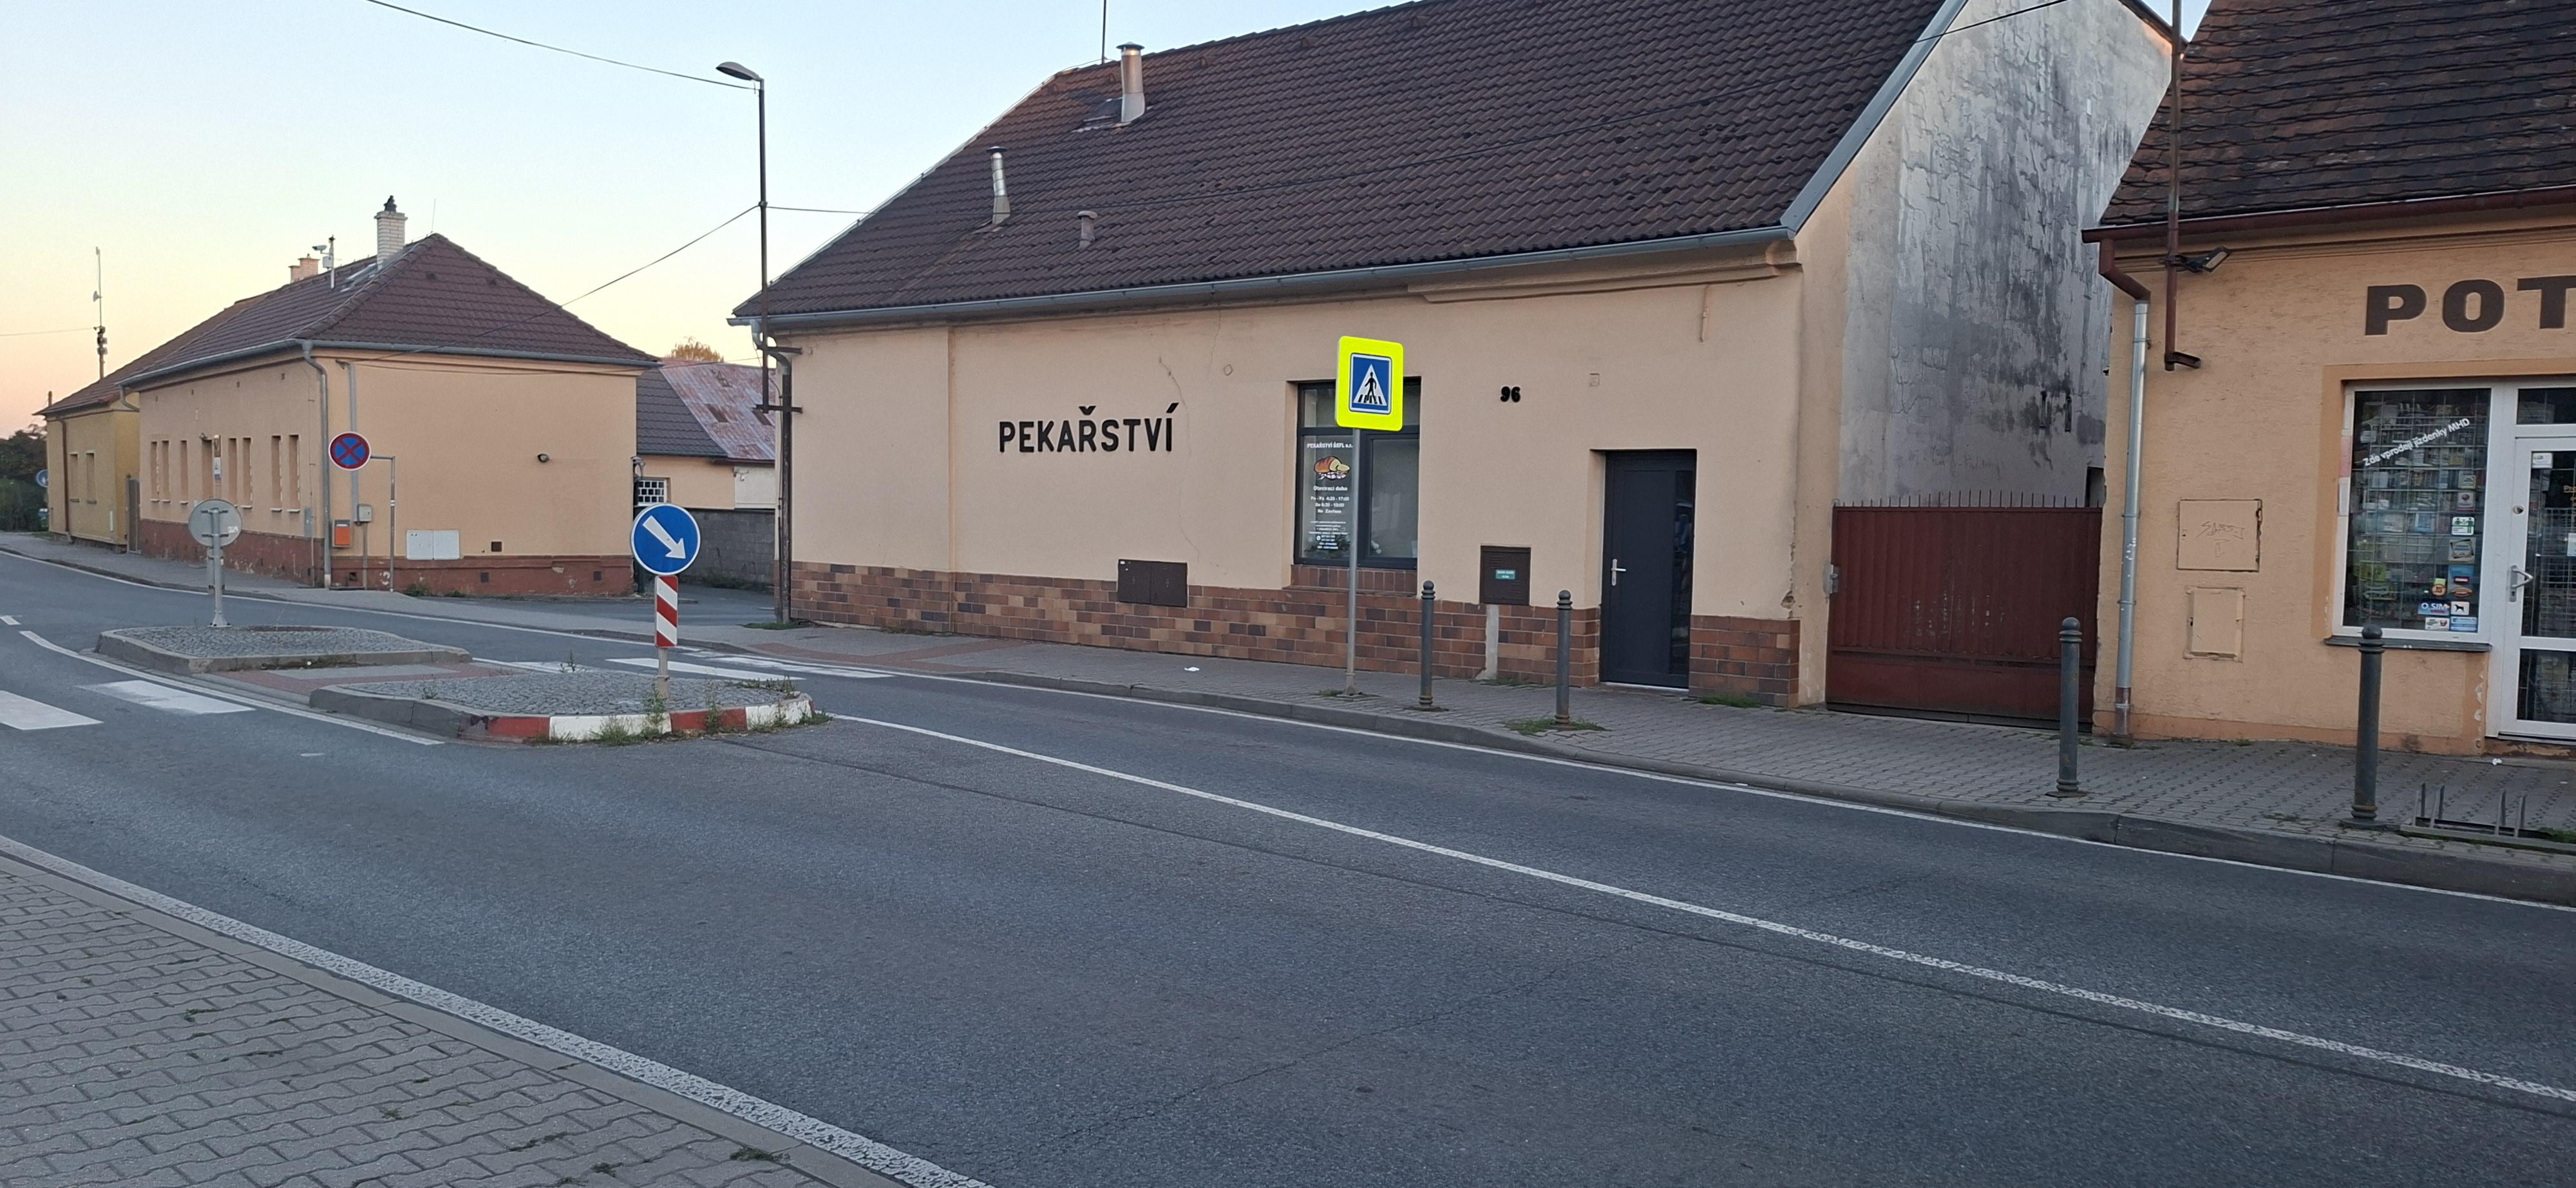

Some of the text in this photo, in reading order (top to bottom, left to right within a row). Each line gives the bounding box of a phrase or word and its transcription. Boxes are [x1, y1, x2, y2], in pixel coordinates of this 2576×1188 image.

[2365, 275, 2576, 336] POT
[1500, 386, 1521, 403] 96
[999, 402, 1179, 452] PEKAŘSTVÍ
[2447, 418, 2470, 433] MHD
